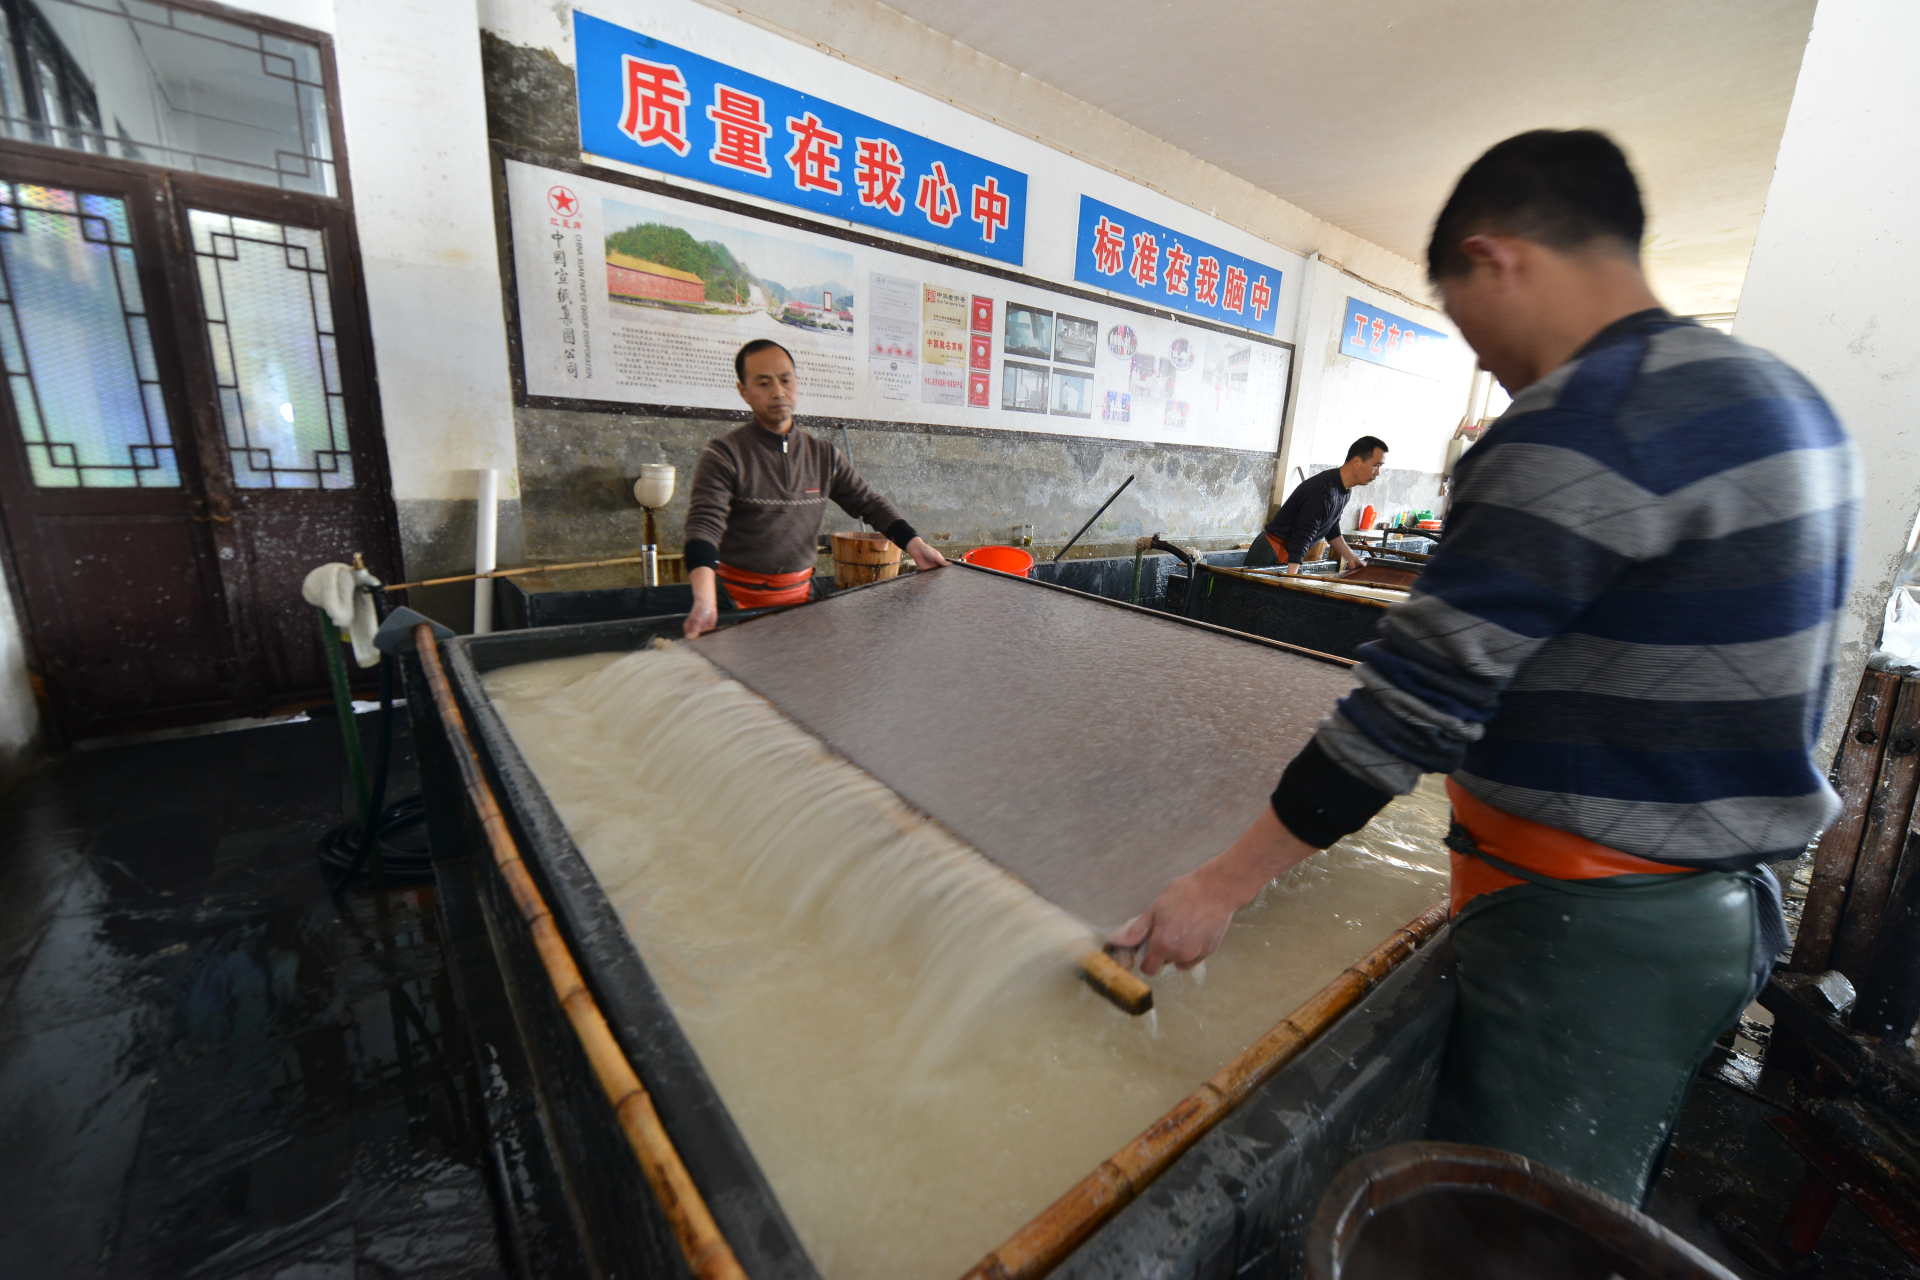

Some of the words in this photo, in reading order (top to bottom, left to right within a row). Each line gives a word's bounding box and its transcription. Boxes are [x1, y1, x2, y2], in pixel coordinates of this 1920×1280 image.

[618, 55, 1009, 242] 质量在我心中
[575, 234, 584, 256] CHINA
[577, 257, 586, 278] XUAN
[1093, 216, 1271, 320] 标准在我脑中
[579, 278, 588, 303] PAPER
[581, 304, 589, 329] GROUP
[1350, 313, 1430, 358] 工艺在我
[583, 330, 593, 379] CORPORATION
